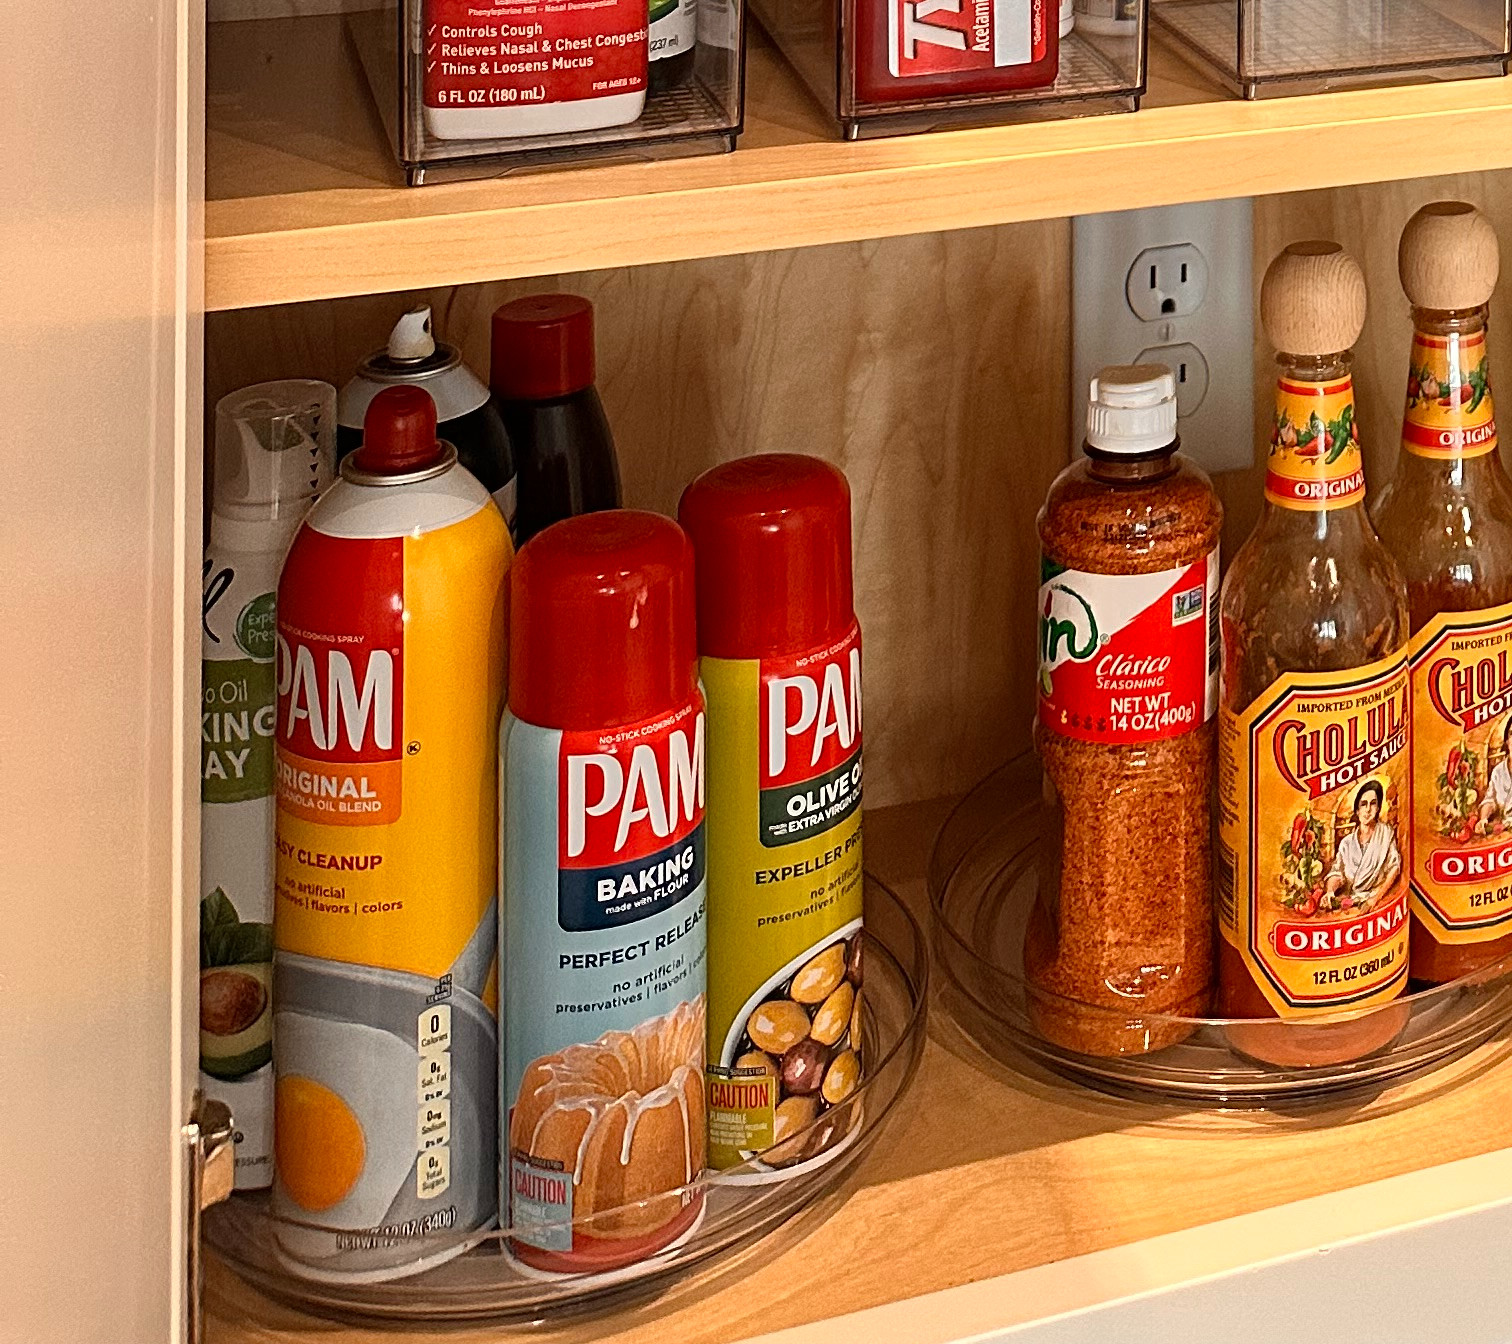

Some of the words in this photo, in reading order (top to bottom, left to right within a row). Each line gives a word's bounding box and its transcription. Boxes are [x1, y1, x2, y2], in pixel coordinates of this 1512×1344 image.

[442, 25, 498, 38] Controls
[501, 23, 543, 37] Cough
[442, 43, 497, 56] Relieves
[500, 40, 538, 54] Nasal
[555, 37, 593, 51] Chest
[441, 61, 476, 75] Thins
[493, 58, 548, 73] Loosens
[552, 55, 593, 70] Mucus
[439, 90, 447, 102] 6
[450, 89, 465, 102] FL
[469, 88, 485, 101] OZ
[489, 88, 517, 103] (180
[520, 86, 545, 100] mL)
[1096, 654, 1171, 676] Clásico
[1111, 697, 1143, 714] NET
[1144, 692, 1171, 709] WT
[1474, 698, 1512, 725] HOT
[1110, 715, 1128, 731] 14
[567, 712, 704, 857] PAM
[1320, 758, 1365, 792] HOT
[338, 800, 382, 812] BLEND
[786, 776, 849, 816] OLIVE
[788, 813, 824, 833] EXTRA
[298, 850, 383, 871] CLEANUP
[756, 847, 842, 885] EXPELLER
[597, 846, 693, 902] BAKING
[654, 873, 689, 902] FLOUR
[560, 941, 650, 968] PERFECT
[613, 982, 630, 993] no
[636, 954, 684, 986] artificial
[709, 1082, 769, 1109] CAUTION
